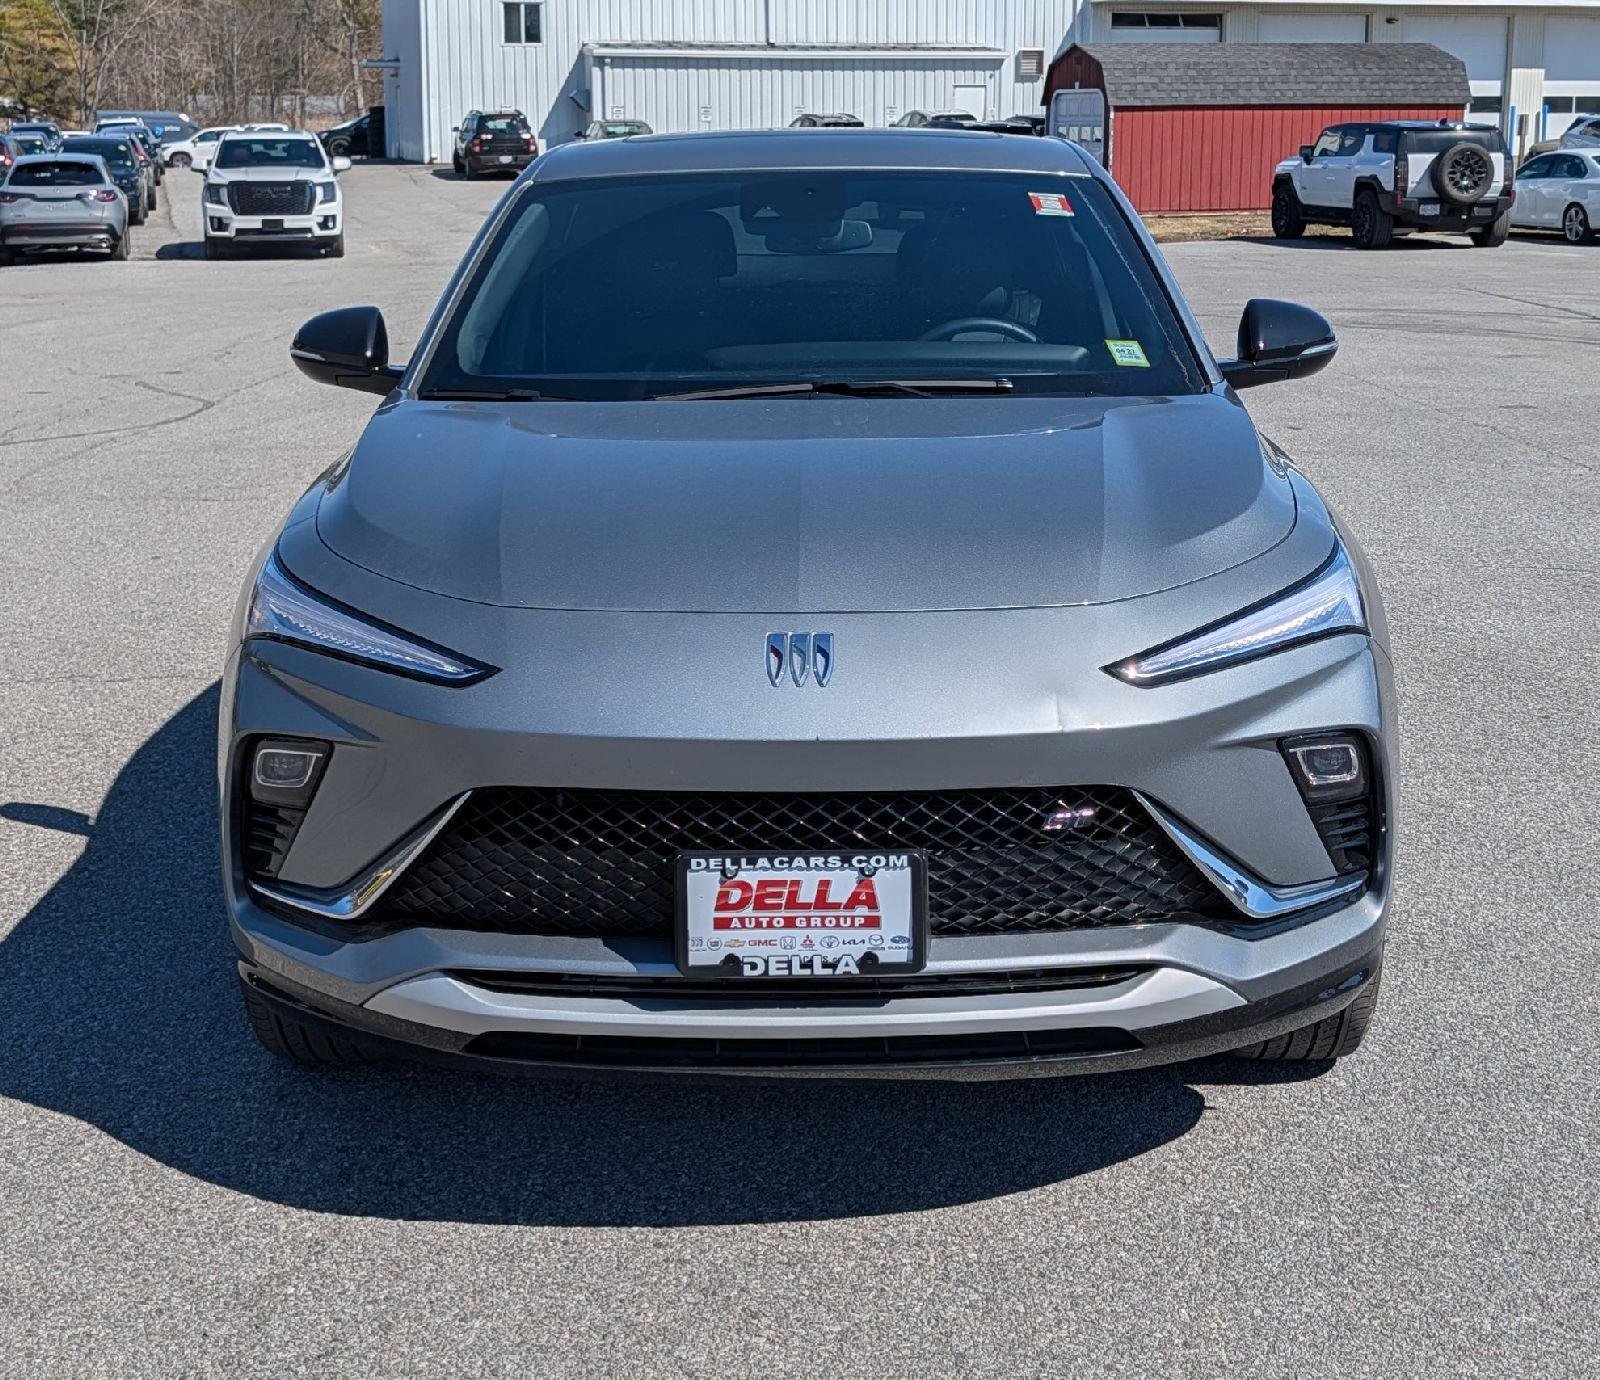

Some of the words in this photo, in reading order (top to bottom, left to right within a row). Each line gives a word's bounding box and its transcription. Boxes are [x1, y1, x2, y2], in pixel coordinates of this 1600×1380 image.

[690, 855, 908, 870] DELLACARS.COM
[714, 879, 881, 912] DELLA
[729, 917, 785, 928] AUTO
[795, 916, 865, 927] GROUP
[748, 939, 778, 947] GMC
[742, 953, 860, 976] DELLA
